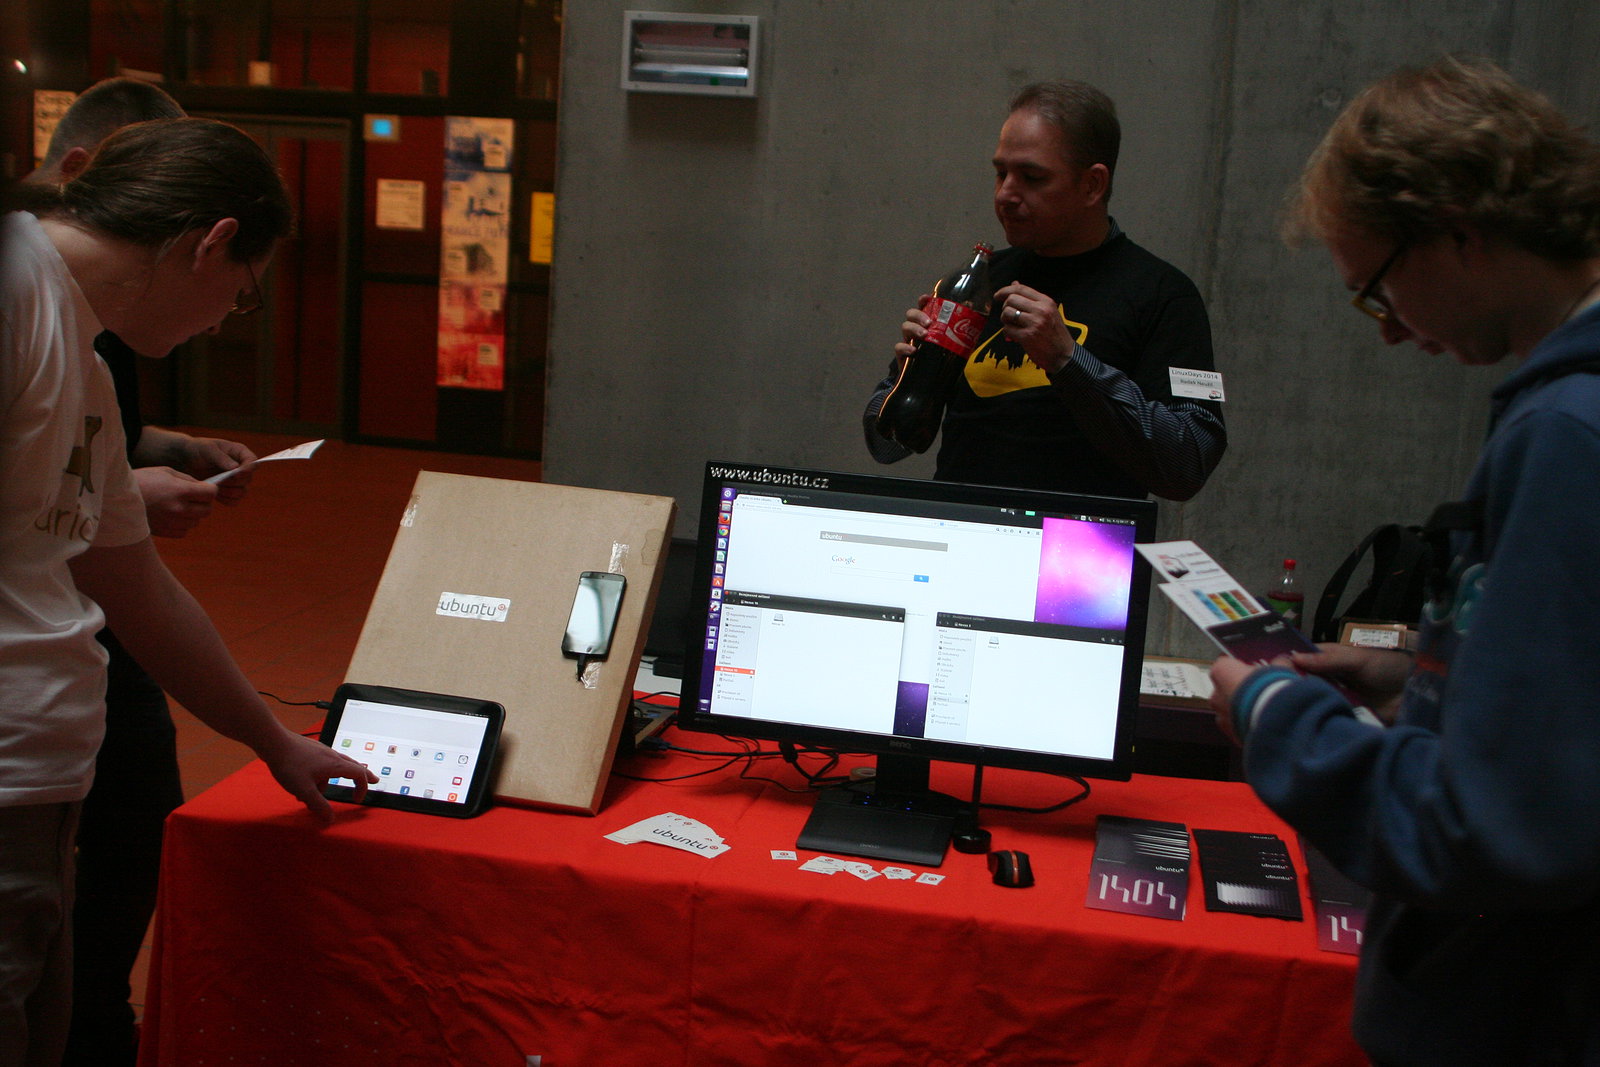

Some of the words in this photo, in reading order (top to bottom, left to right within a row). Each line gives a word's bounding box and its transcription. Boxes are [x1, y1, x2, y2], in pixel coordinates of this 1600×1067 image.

[710, 466, 829, 489] www.ubuntu.cz
[831, 554, 856, 565] Google
[440, 597, 497, 616] ubuntu
[652, 828, 708, 850] ubuntu
